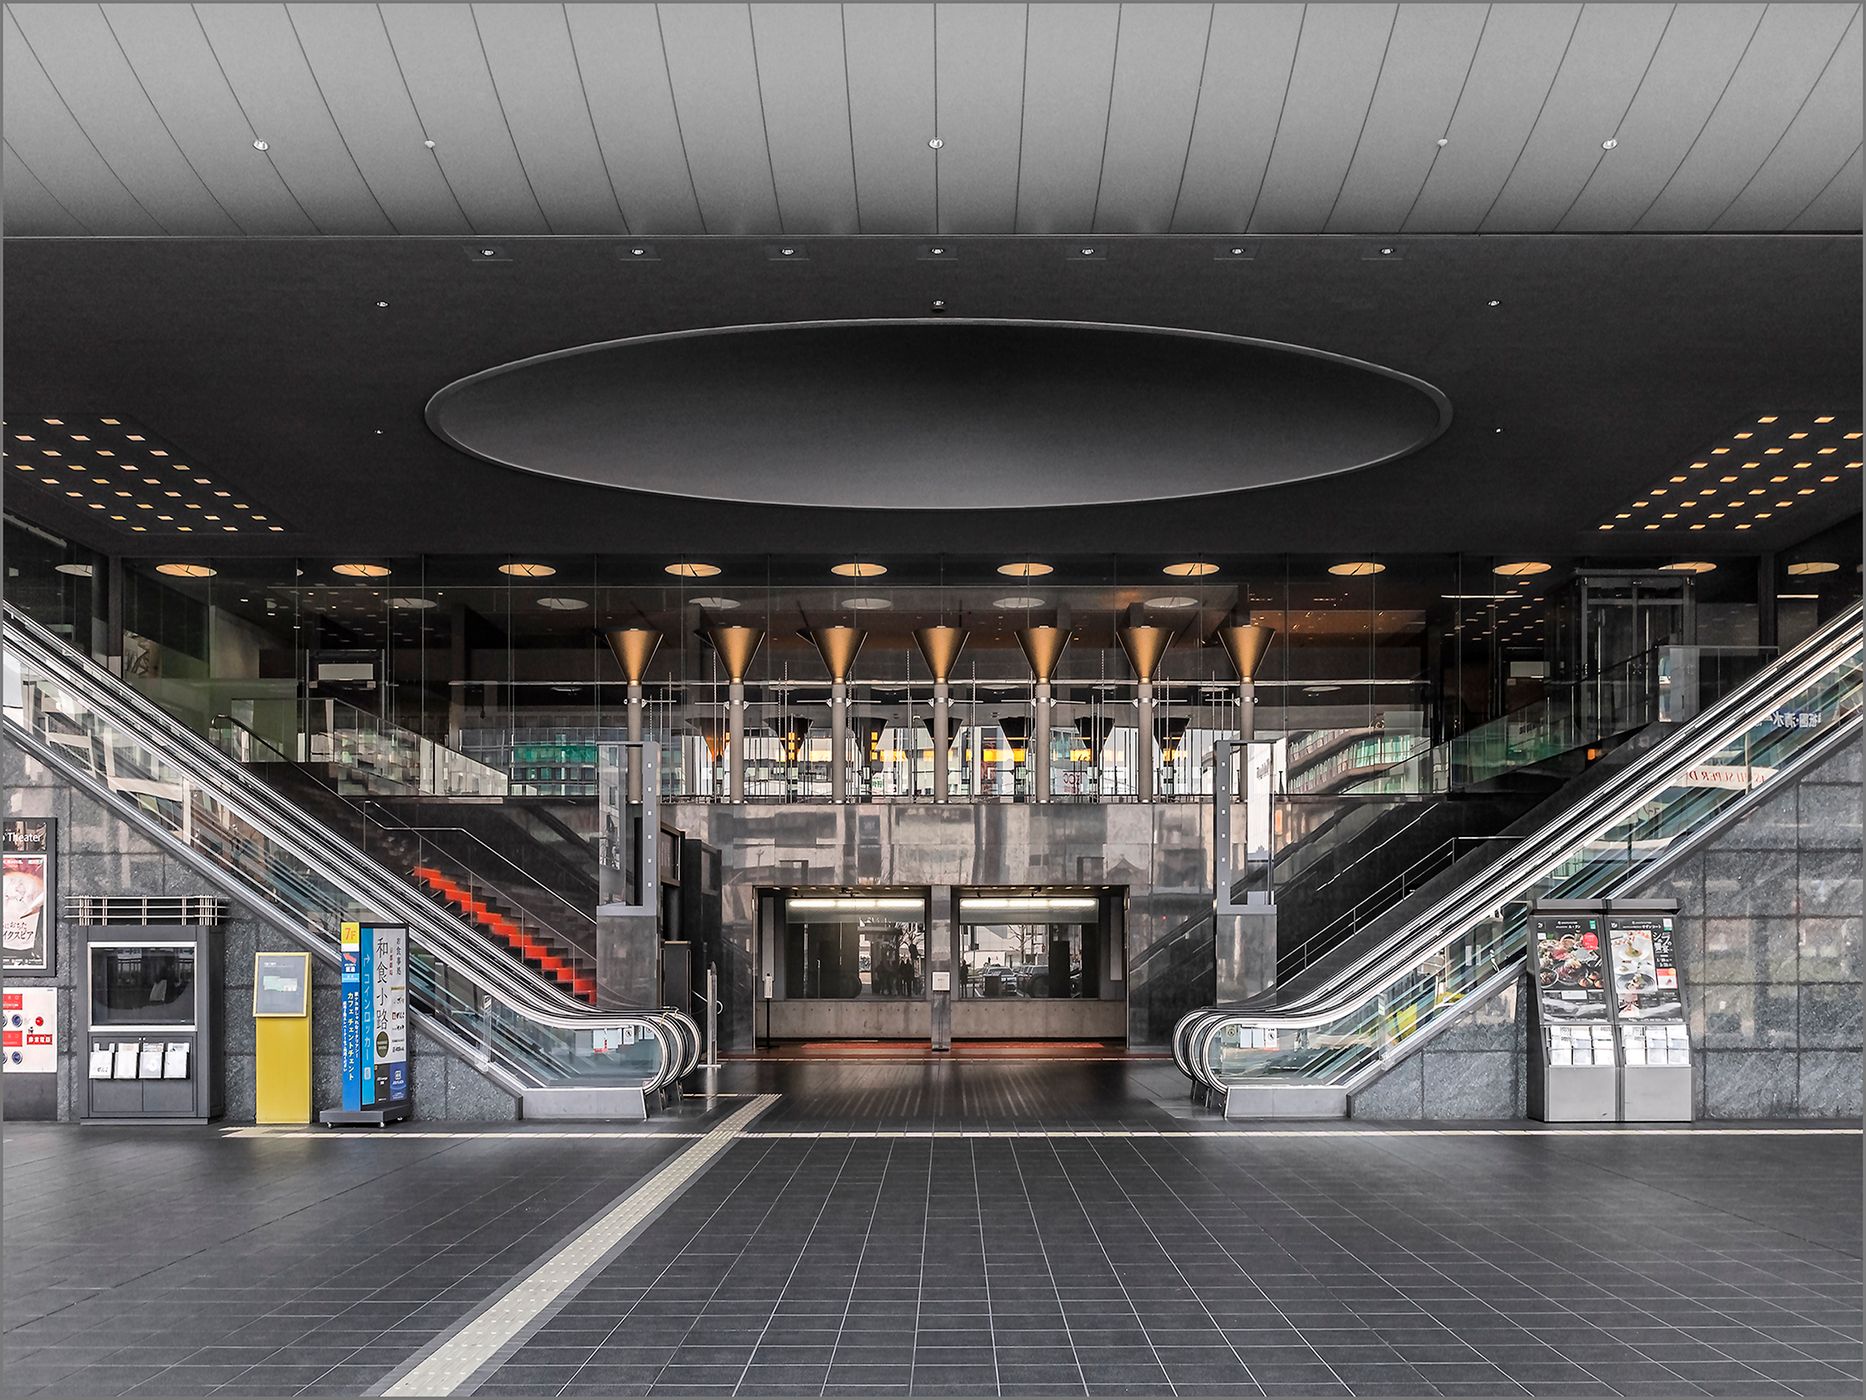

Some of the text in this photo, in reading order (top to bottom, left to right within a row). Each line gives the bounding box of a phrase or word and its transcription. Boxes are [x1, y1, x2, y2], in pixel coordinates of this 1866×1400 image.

[8, 832, 41, 842] Theater
[345, 927, 356, 941] 7F
[375, 936, 389, 1031] 和食小路
